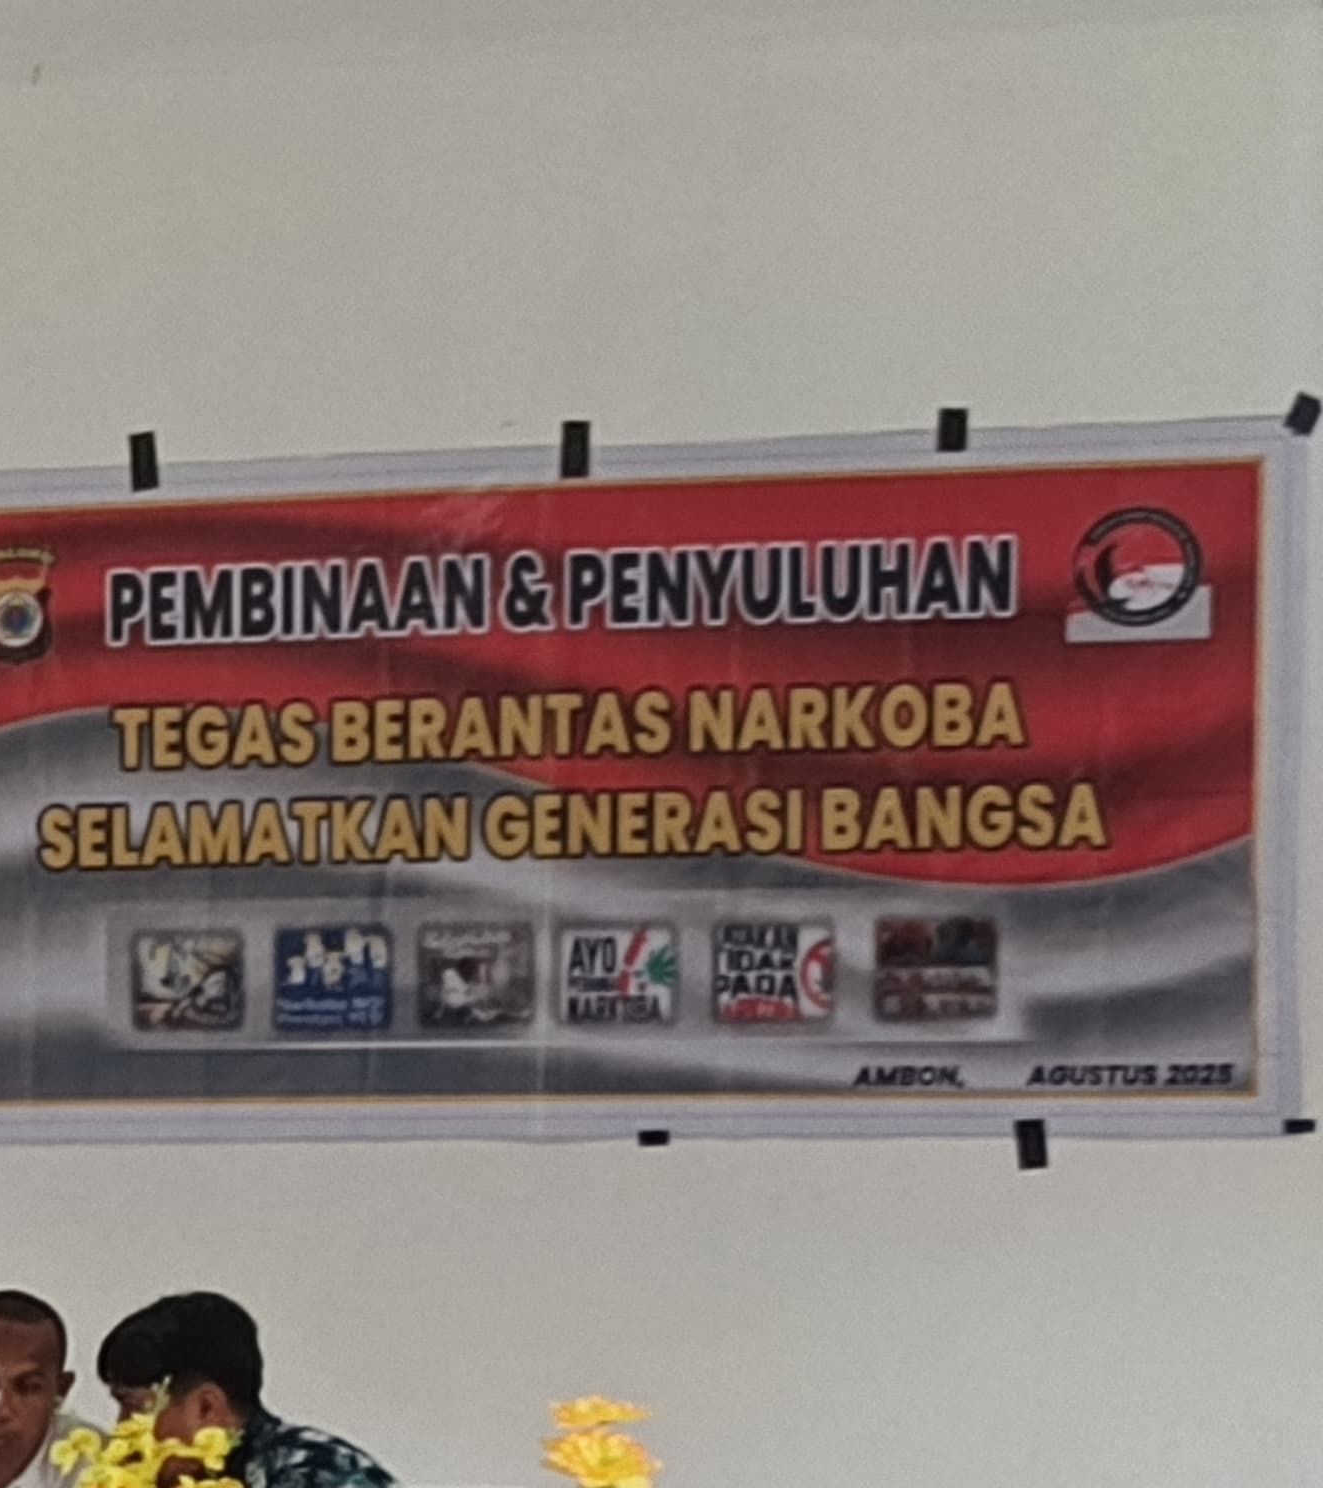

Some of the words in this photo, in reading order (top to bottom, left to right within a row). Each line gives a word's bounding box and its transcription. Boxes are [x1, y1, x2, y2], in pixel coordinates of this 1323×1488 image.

[107, 551, 489, 645] PEMBINAAN
[504, 549, 552, 633] &
[564, 537, 1018, 630] PENYULUHAN
[112, 702, 316, 771] TEGAS
[330, 690, 672, 763] BERANTAS
[688, 683, 1028, 754] NARKOBA
[37, 794, 471, 870] SELAMATKAN
[484, 786, 804, 858] GENERASI
[821, 783, 1108, 851] BANGSA
[568, 936, 617, 975] AYO
[853, 1064, 965, 1089] AMBON,
[1026, 1063, 1158, 1087] AGUSTUS
